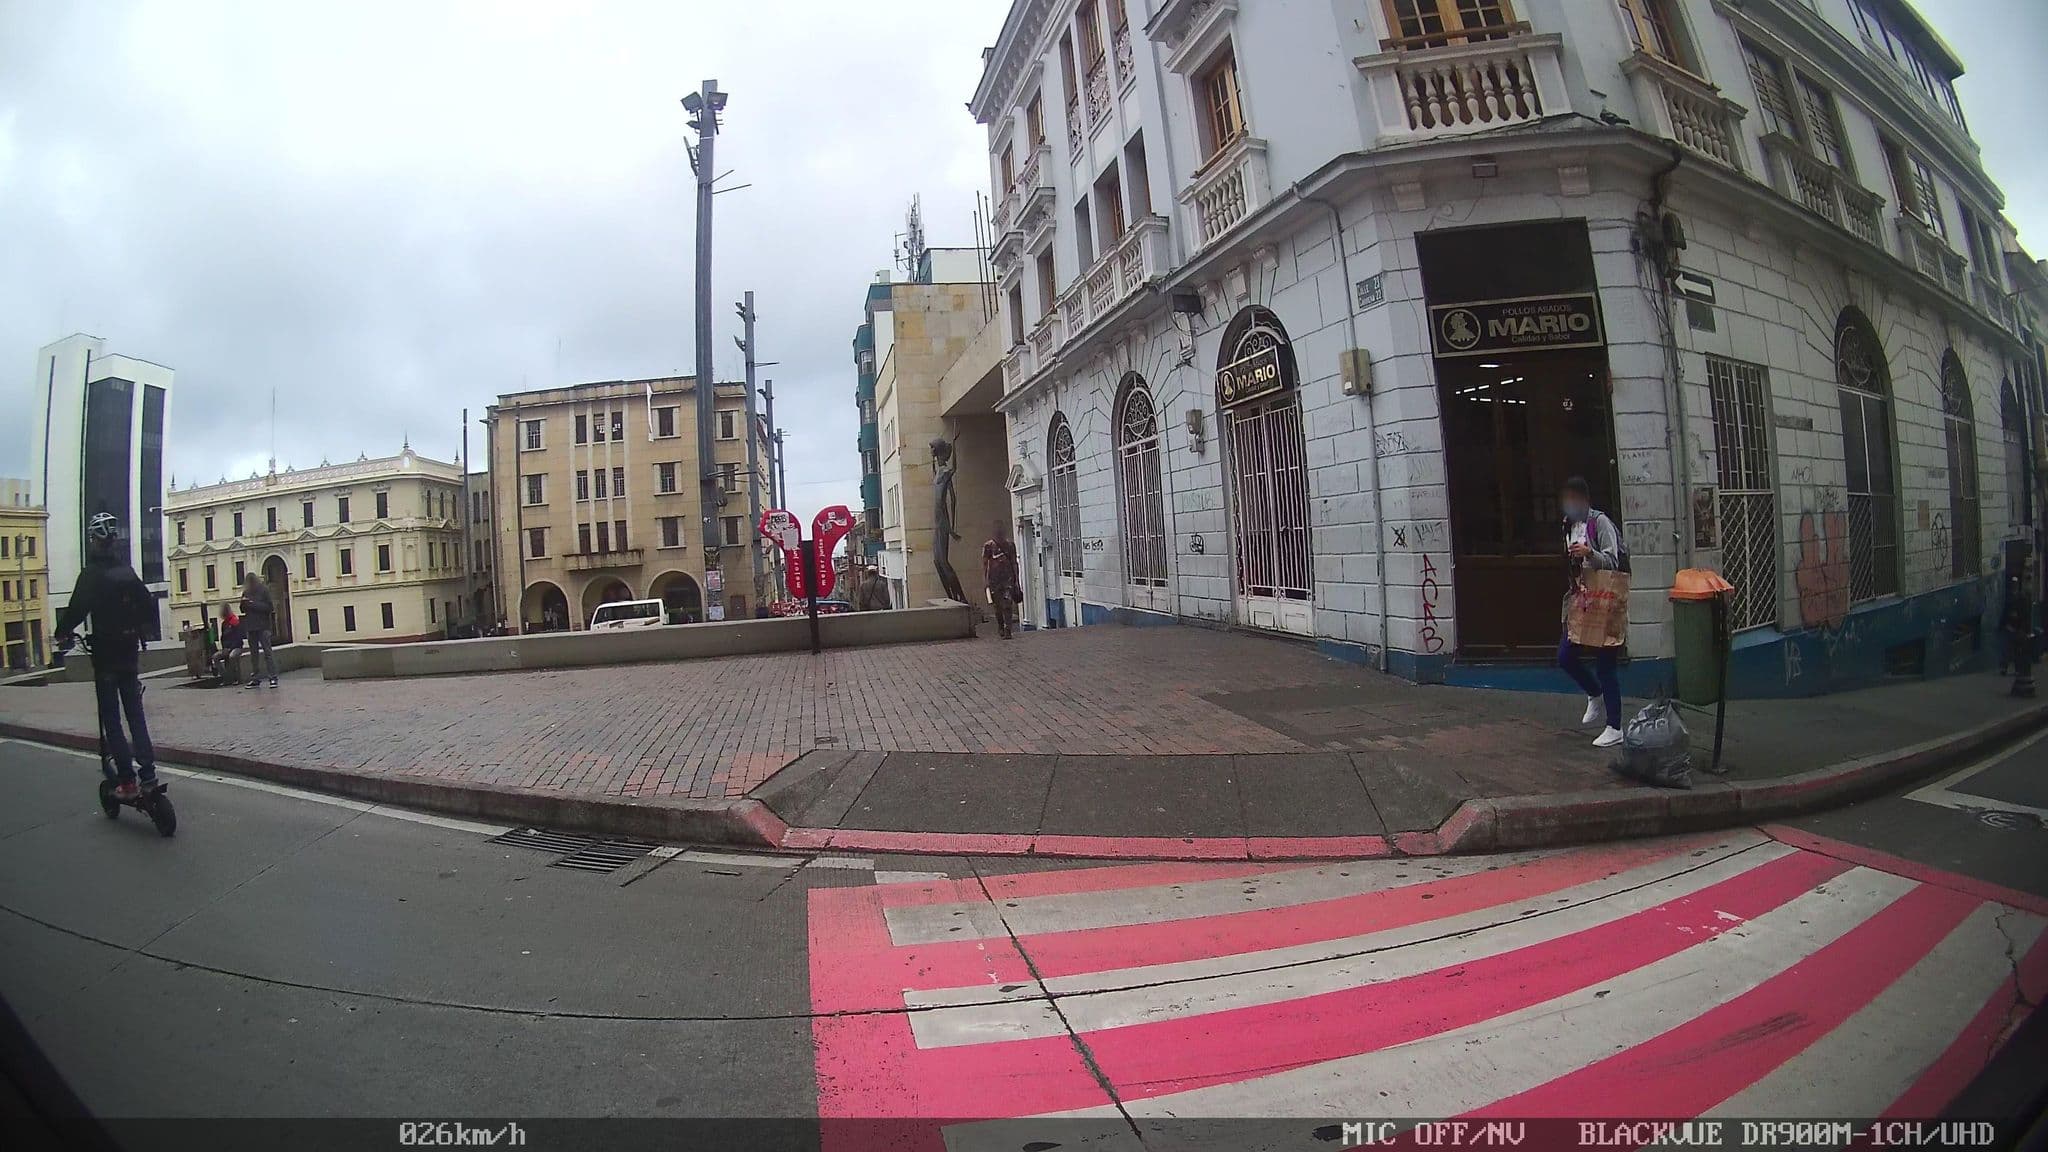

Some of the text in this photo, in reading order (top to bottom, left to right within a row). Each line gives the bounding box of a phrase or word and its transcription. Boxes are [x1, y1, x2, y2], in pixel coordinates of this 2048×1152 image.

[1502, 304, 1572, 316] POLLOS ASADOS
[1488, 313, 1590, 337] MARIO
[1511, 334, 1541, 344] Calidad
[1549, 333, 1570, 342] Sabor
[1236, 364, 1276, 390] MARIO
[1420, 553, 1444, 654] ACAB
